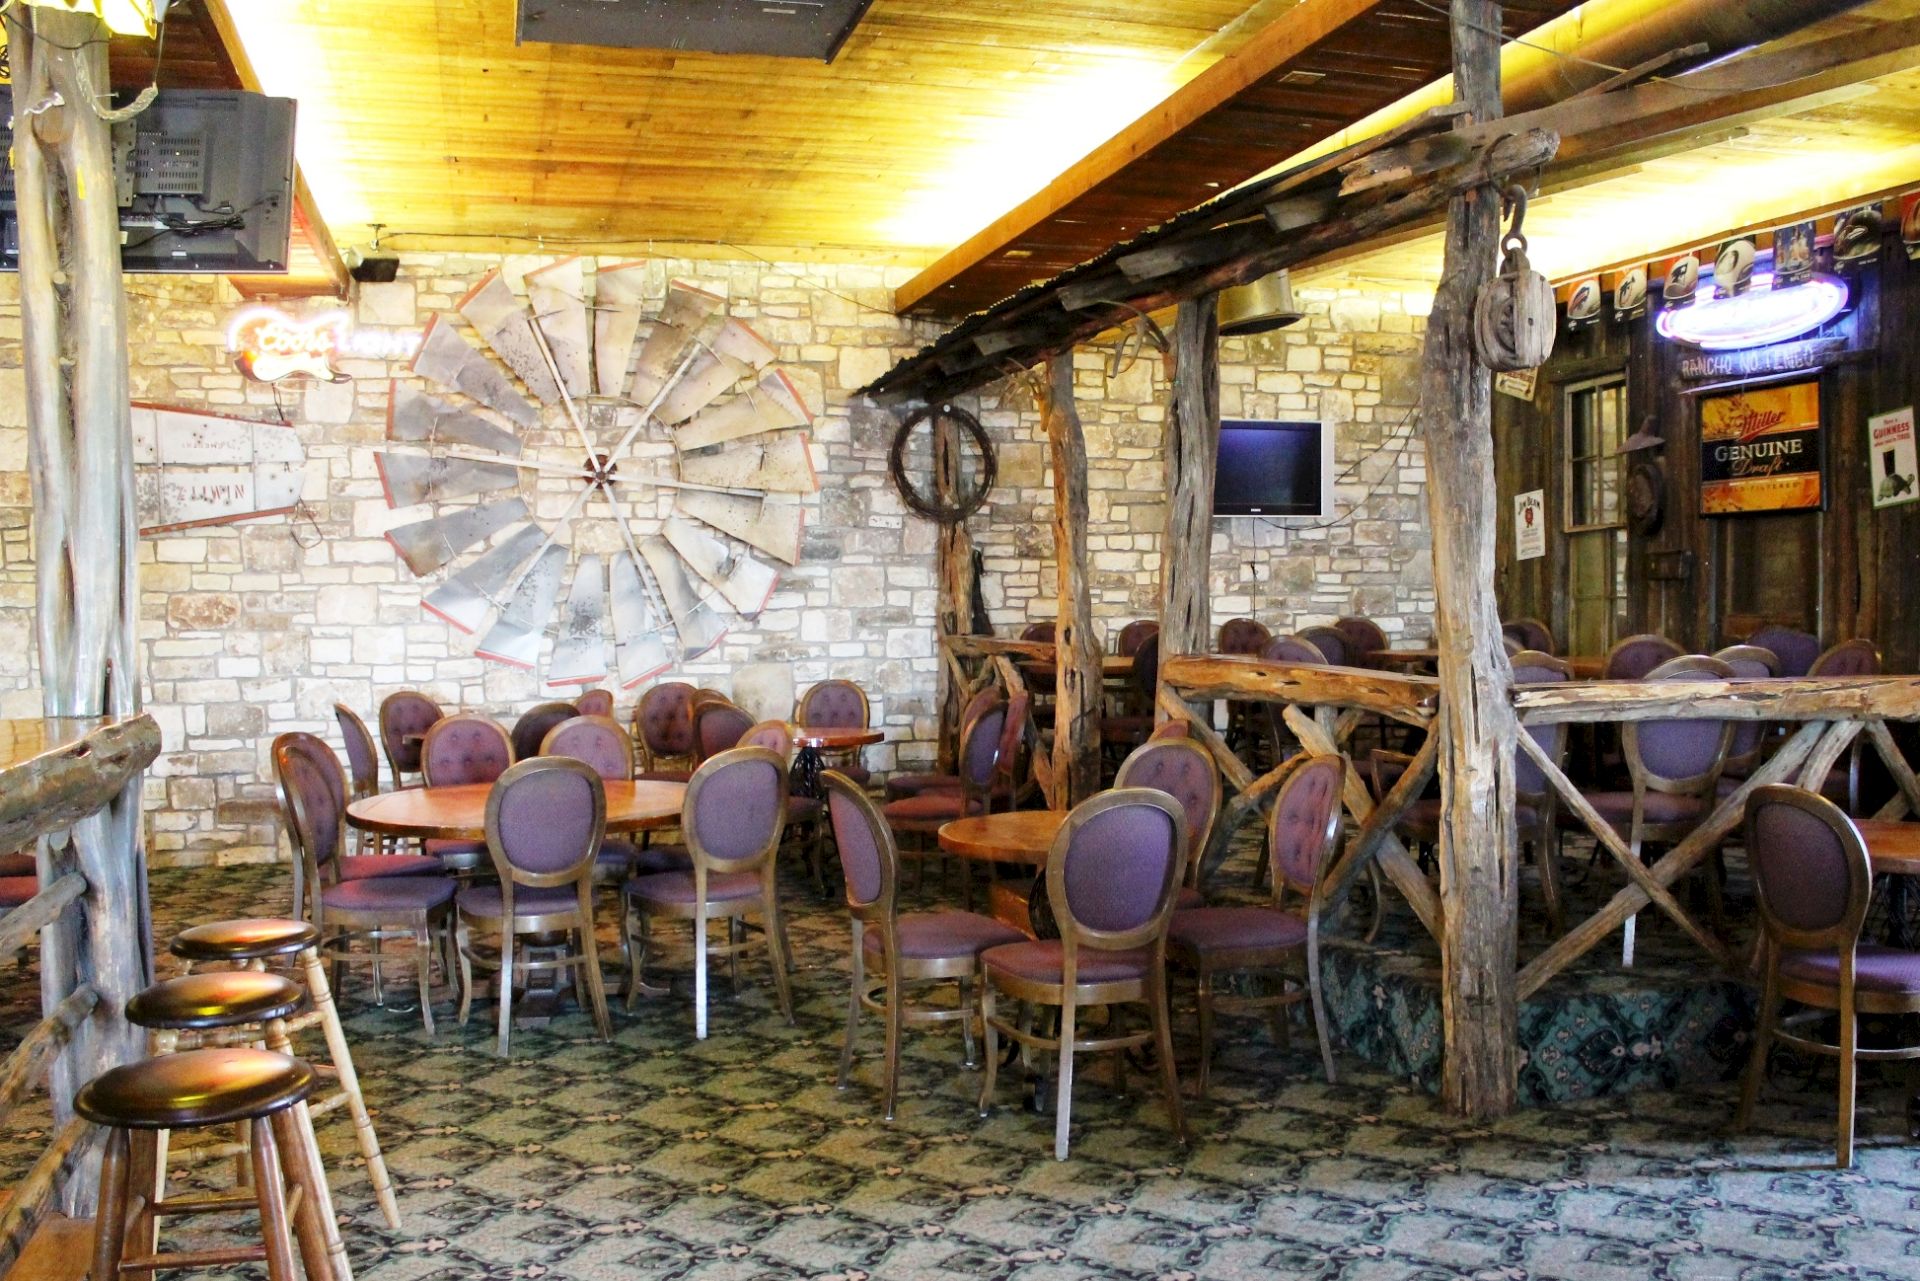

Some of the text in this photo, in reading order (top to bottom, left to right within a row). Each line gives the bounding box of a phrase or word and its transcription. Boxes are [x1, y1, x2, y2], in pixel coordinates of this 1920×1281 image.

[1682, 355, 1732, 377] RANCHO
[1739, 411, 1786, 440] Miller
[1714, 439, 1803, 462] GENUINE
[1731, 456, 1784, 477] Draft
